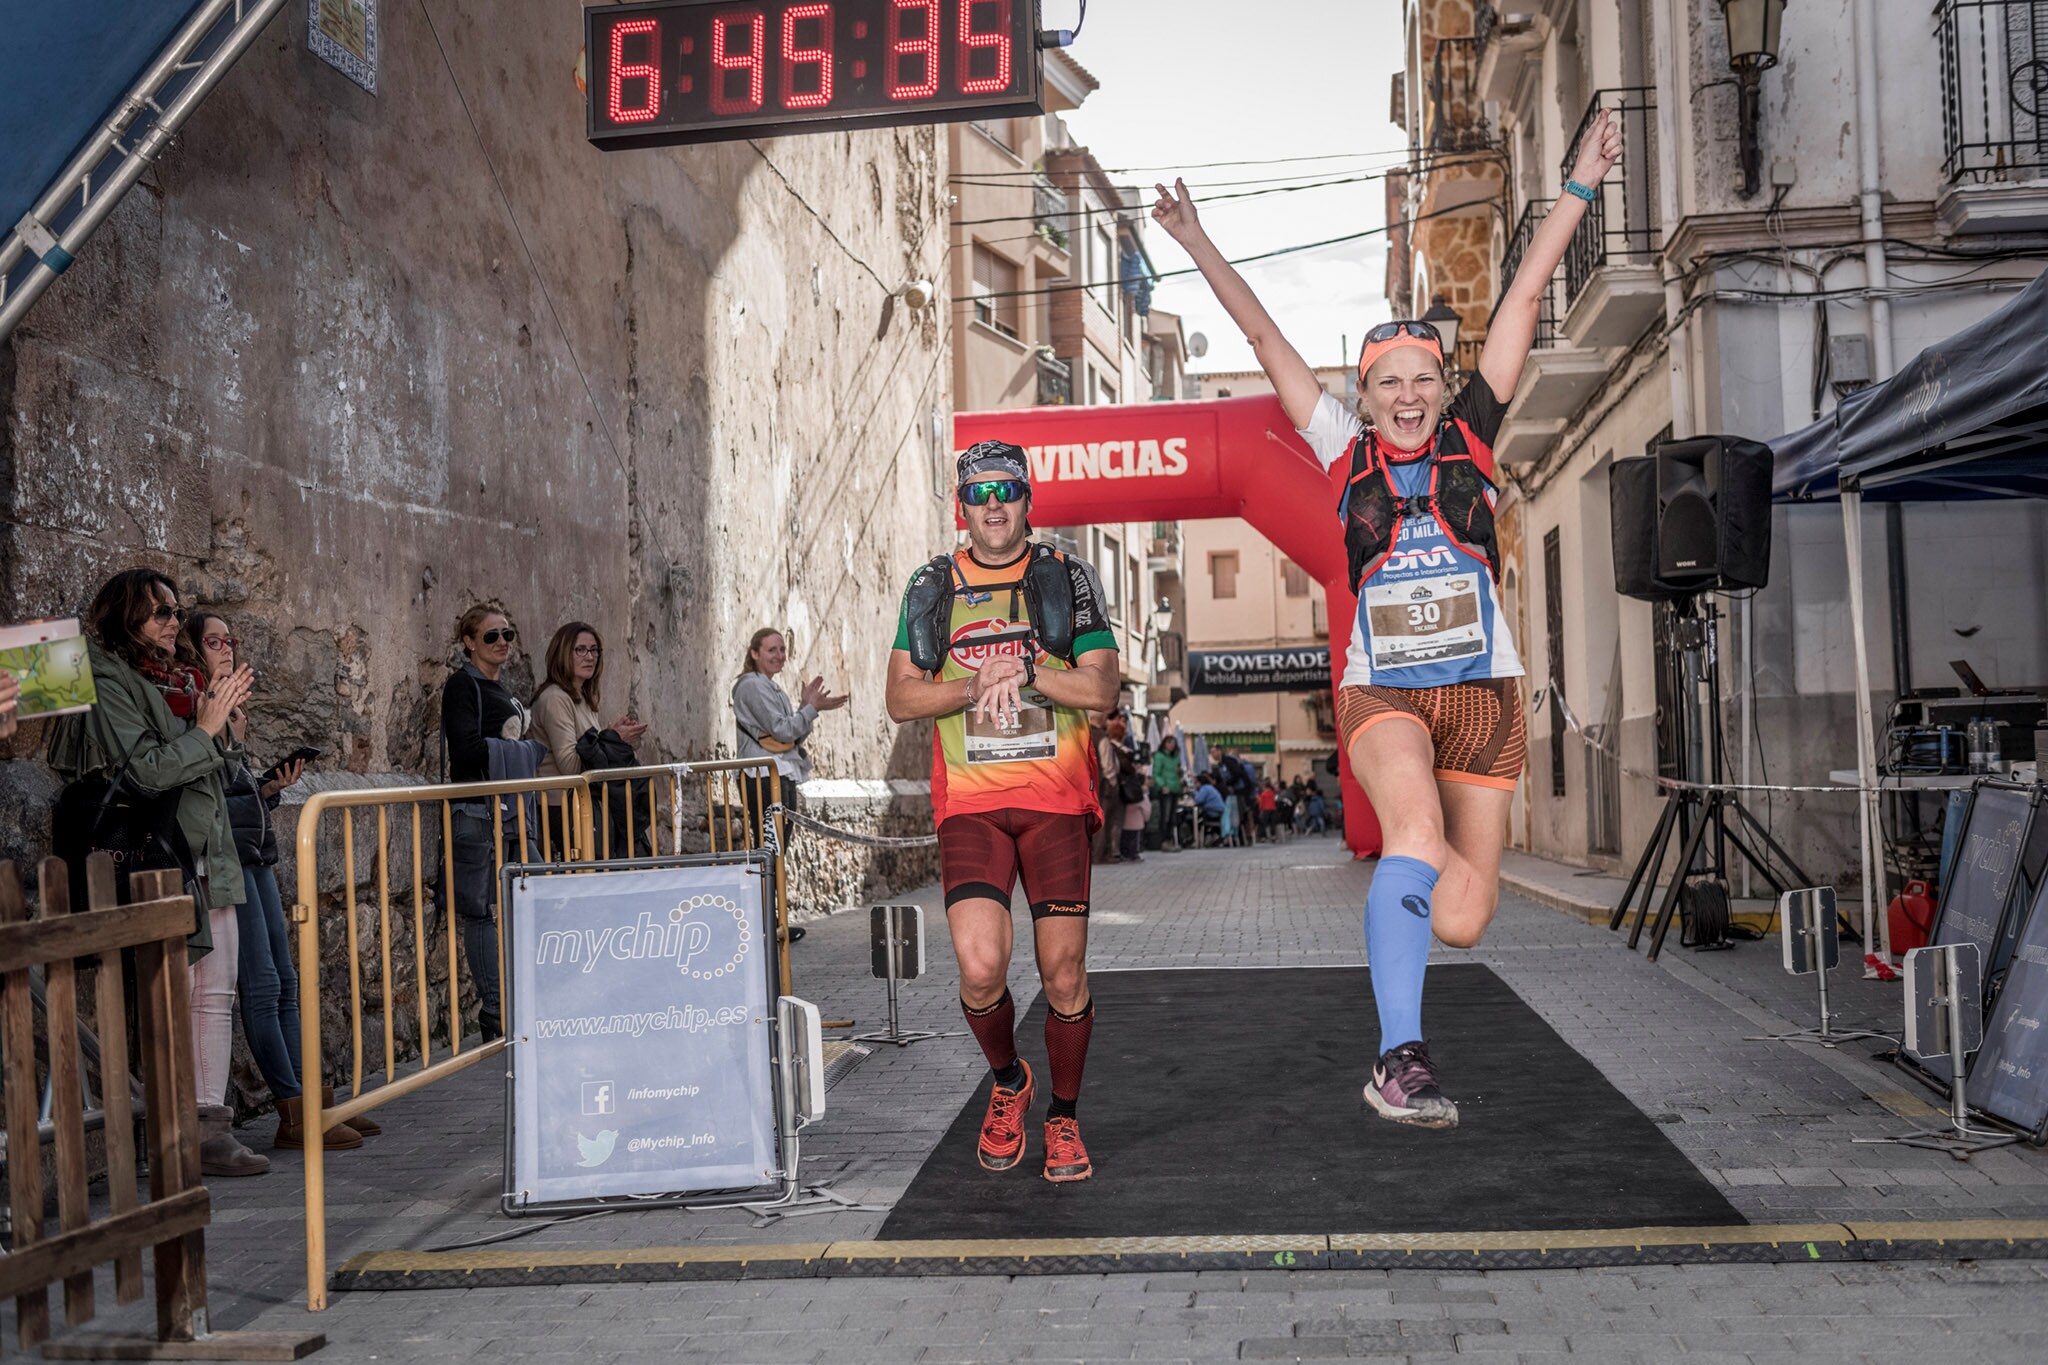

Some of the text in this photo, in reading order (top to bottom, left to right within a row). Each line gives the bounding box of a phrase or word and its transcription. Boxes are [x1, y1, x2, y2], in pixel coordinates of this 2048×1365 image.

[1029, 438, 1188, 482] VINCIAS
[1413, 522, 1443, 539] MILA
[1383, 571, 1413, 580] Proyectos
[1421, 566, 1458, 576] Interiorismo
[1407, 603, 1440, 626] 30
[958, 635, 1042, 660] Serran
[1203, 652, 1330, 671] POWERADE
[1204, 672, 1242, 684] bebida
[1245, 674, 1270, 686] para
[536, 912, 711, 973] mychip
[536, 1005, 748, 1037] www.mychip.es
[628, 1084, 699, 1100] /infomychip
[628, 1133, 715, 1151] @Mychip_Info
